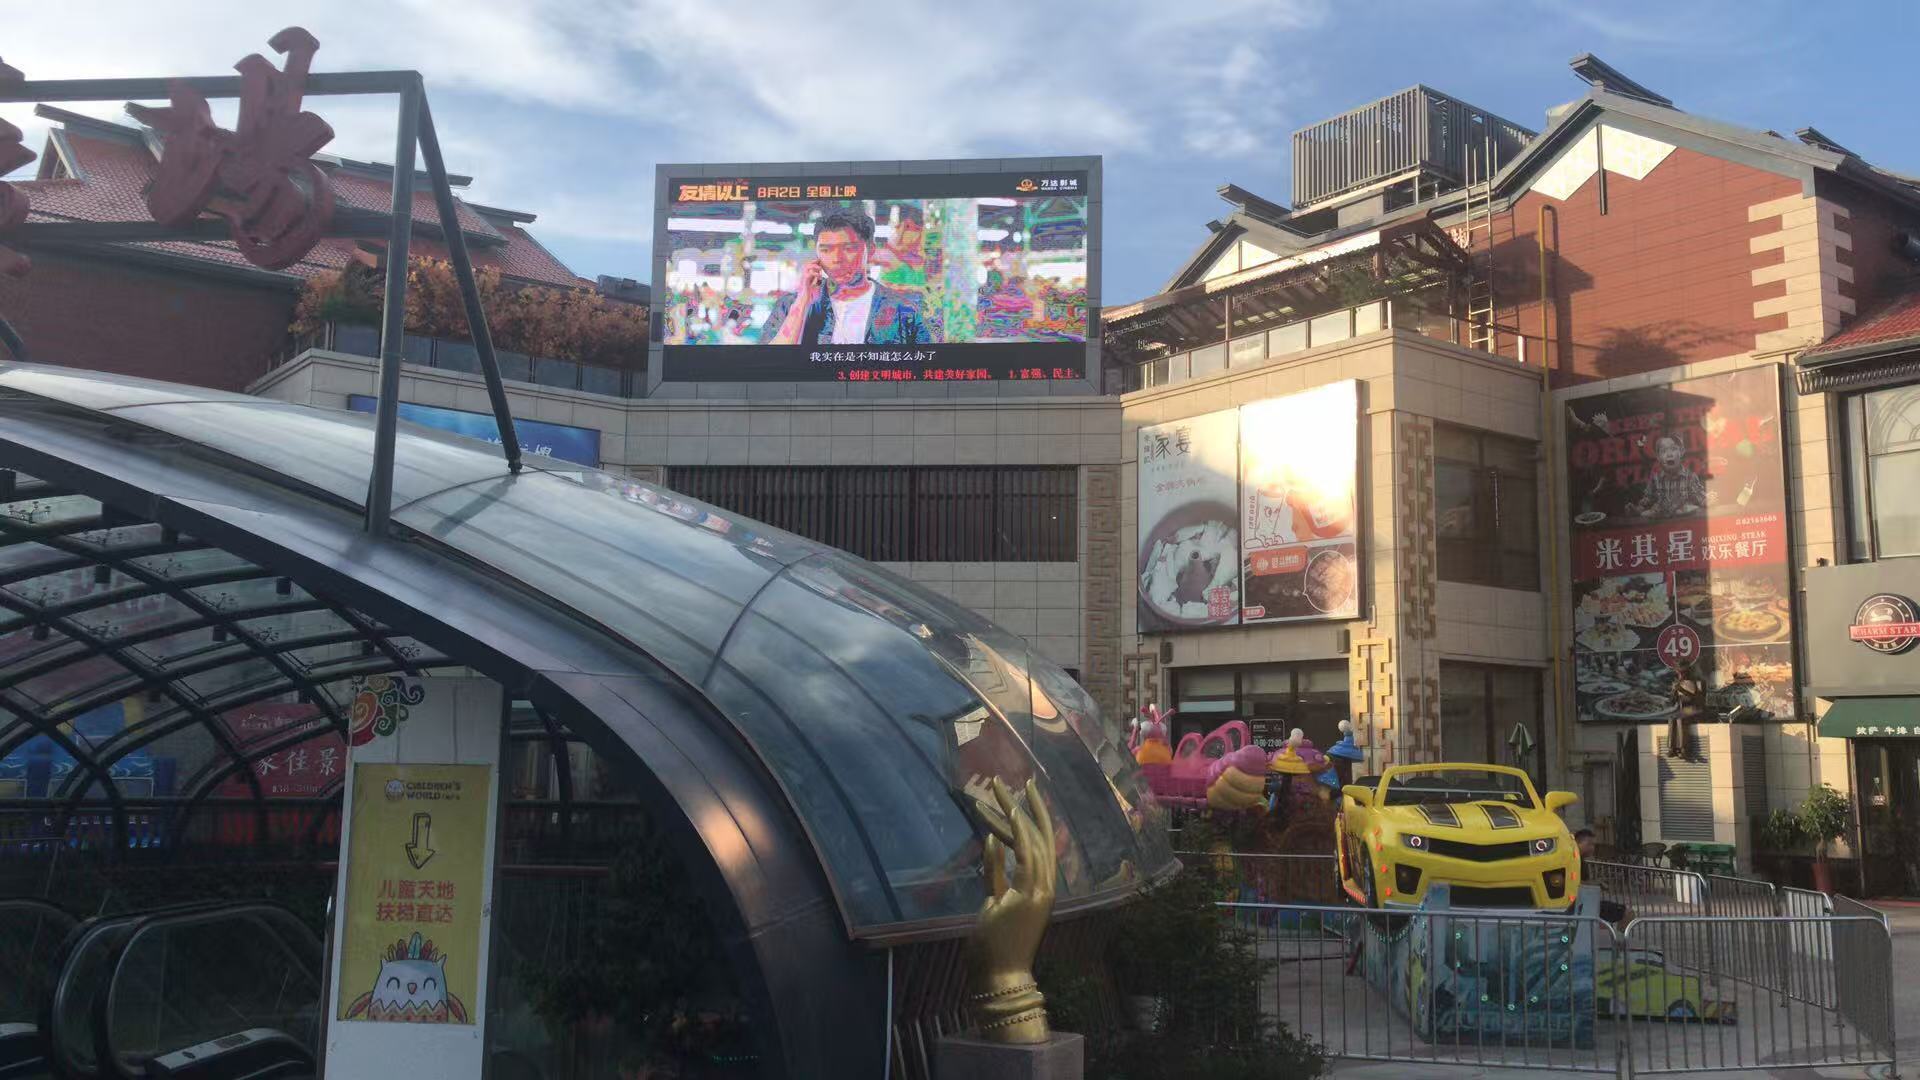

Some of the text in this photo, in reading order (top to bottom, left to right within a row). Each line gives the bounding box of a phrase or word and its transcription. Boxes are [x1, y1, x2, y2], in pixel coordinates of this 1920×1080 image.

[1040, 179, 1077, 187] 万达影城
[757, 186, 800, 198] 8月2日
[806, 185, 857, 197] 全国上映
[810, 351, 936, 362] 我实在是不知道怎么办了
[1741, 530, 1767, 540] STEAK
[1596, 530, 1767, 569] 米其星 欢乐餐厅
[1889, 625, 1917, 635] STAR
[1664, 636, 1692, 657] 49
[377, 879, 455, 899] 儿童天地
